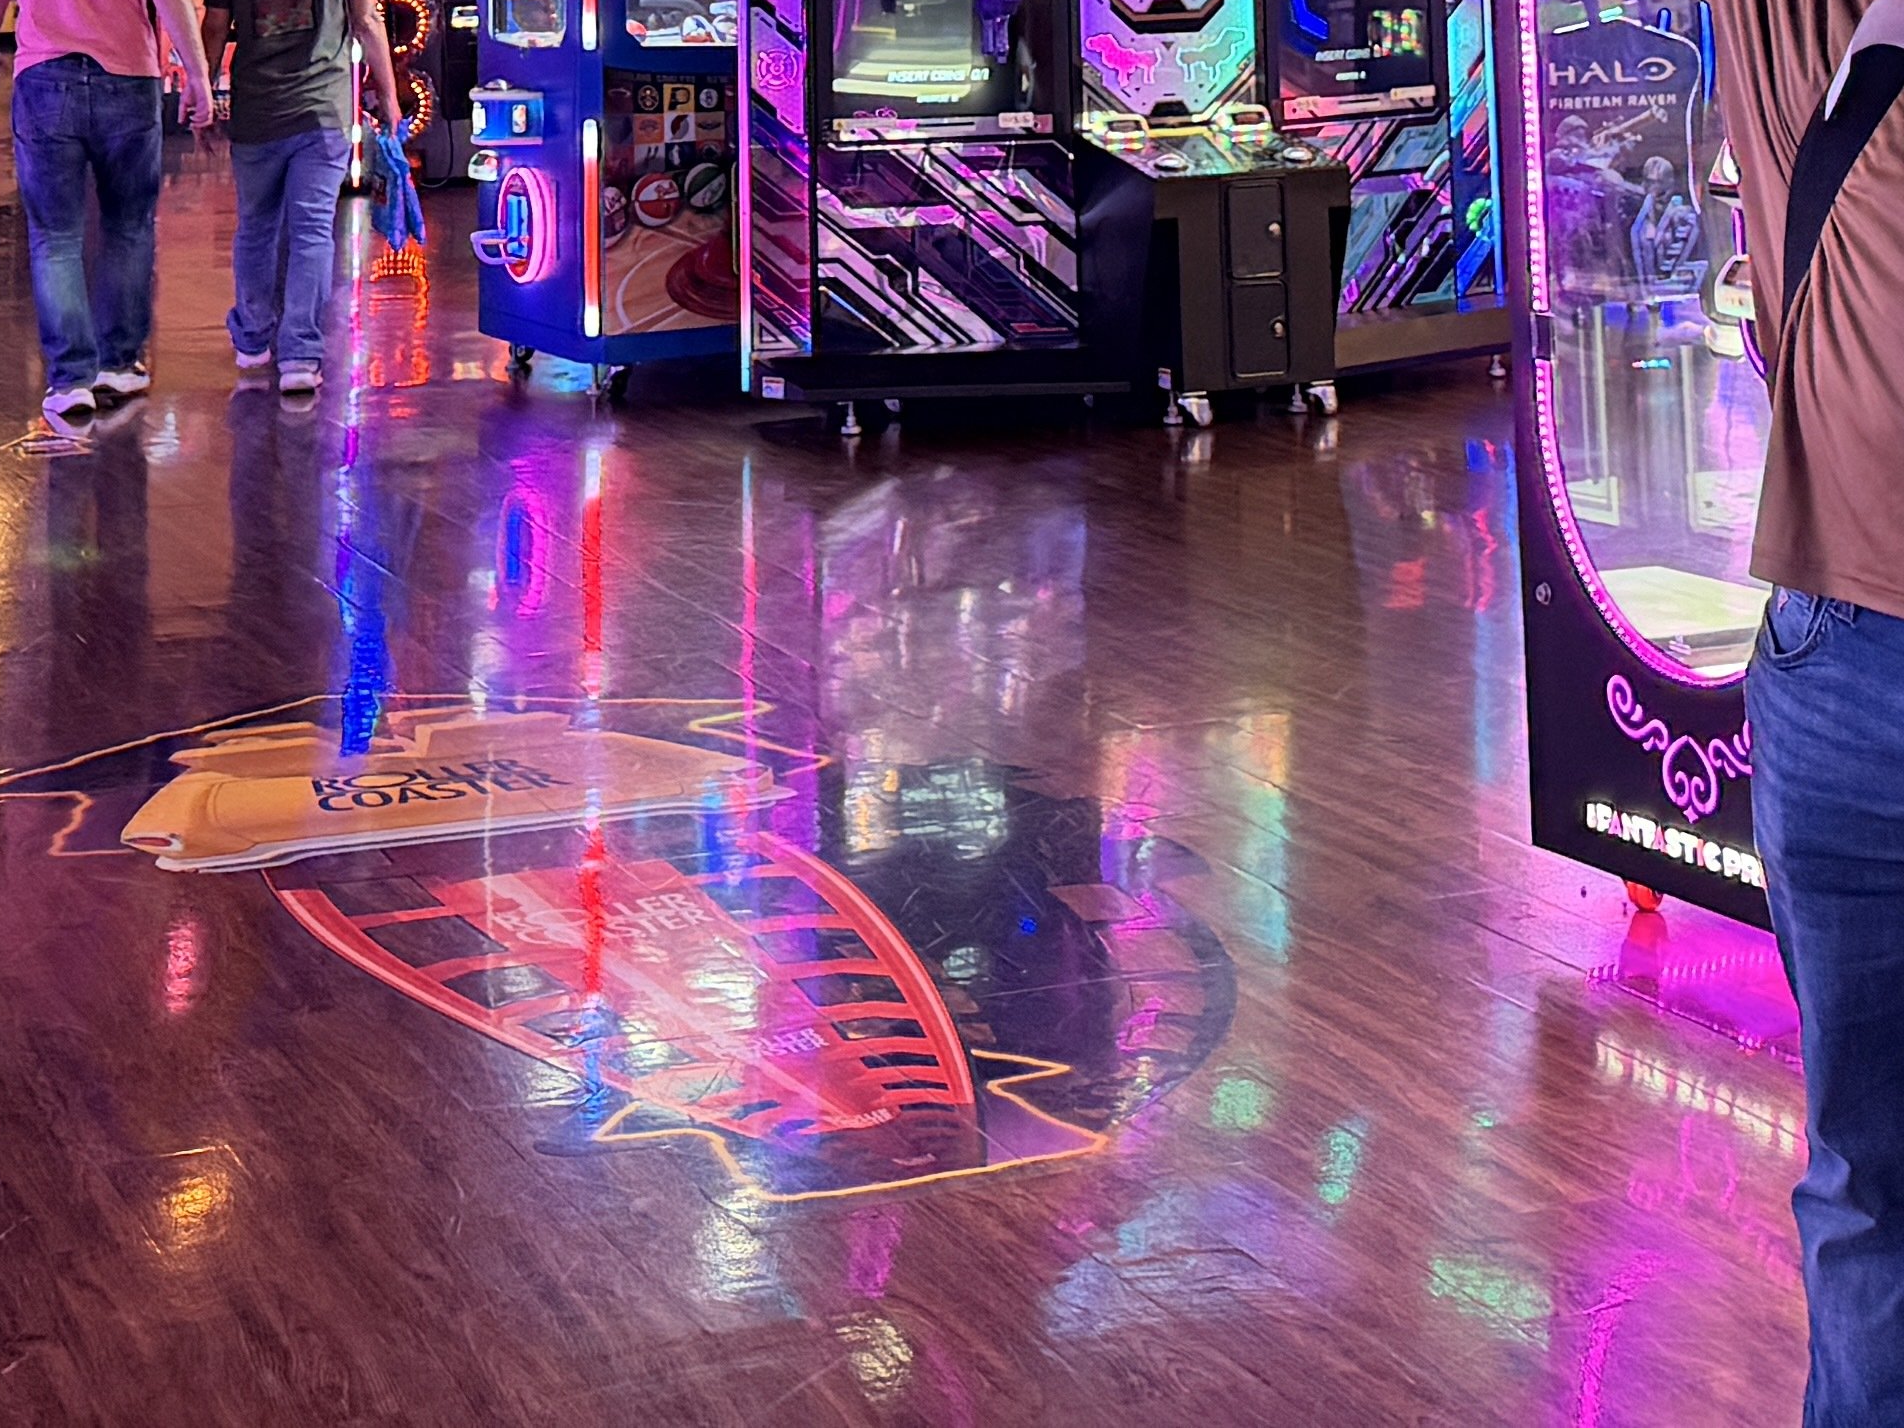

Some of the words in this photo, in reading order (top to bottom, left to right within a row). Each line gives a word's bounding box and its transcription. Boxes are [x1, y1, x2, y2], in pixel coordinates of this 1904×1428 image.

[1548, 56, 1677, 87] HALO
[1549, 95, 1623, 110] FIRETEAM
[1627, 93, 1677, 107] RAVEN
[311, 759, 527, 797] ROLLER
[317, 767, 571, 812] COASTER
